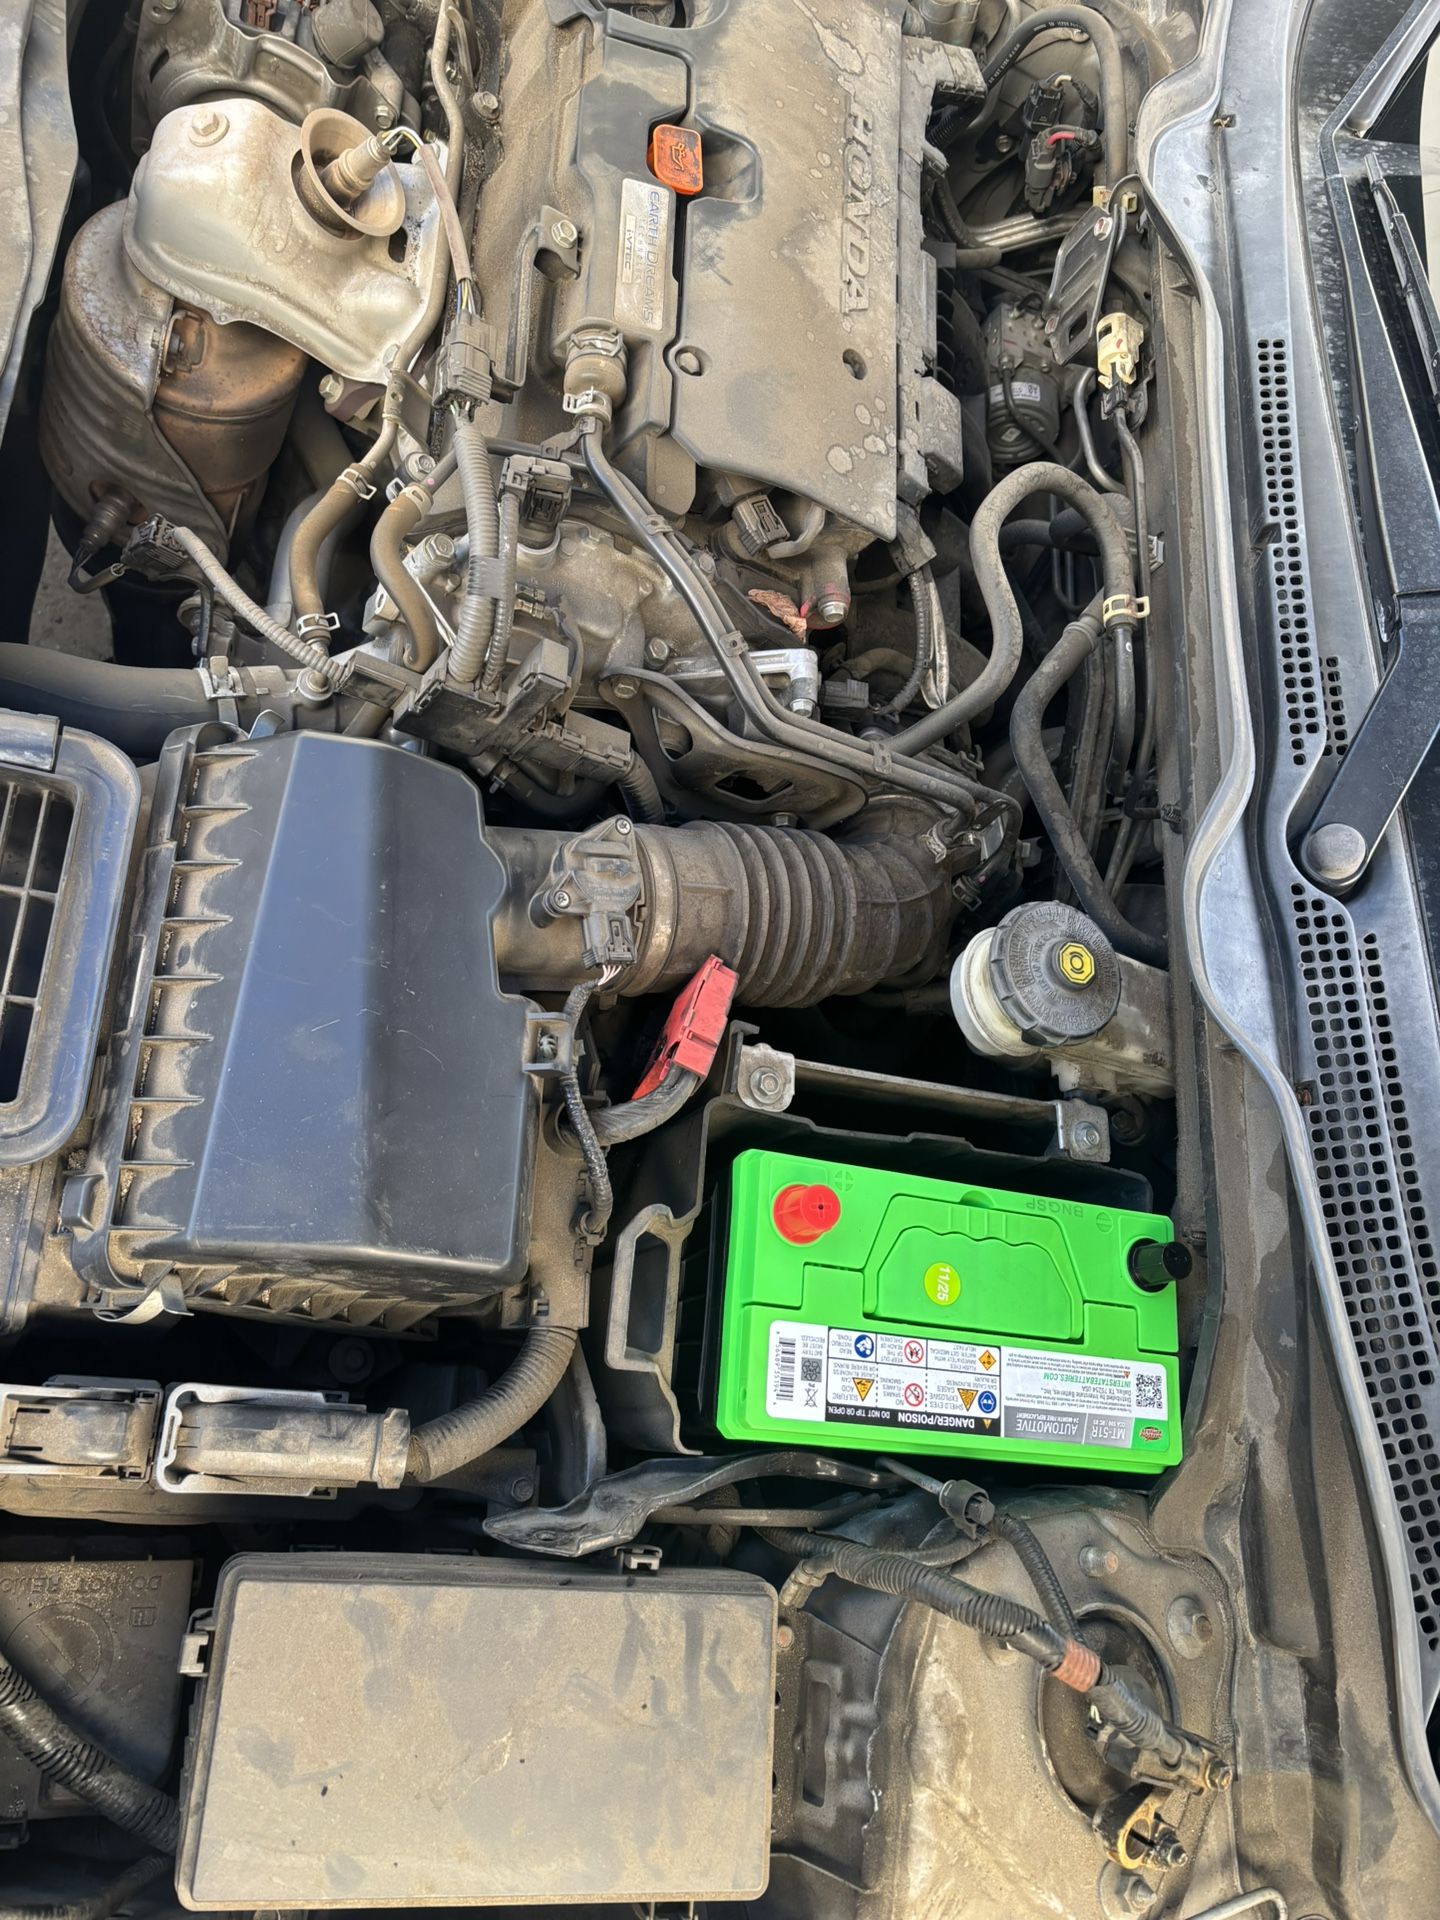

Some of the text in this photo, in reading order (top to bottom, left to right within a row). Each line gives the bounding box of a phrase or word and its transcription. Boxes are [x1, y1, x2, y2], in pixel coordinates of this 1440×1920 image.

[842, 97, 873, 315] HONDA
[642, 190, 660, 325] EARTH DREAMS
[1026, 1198, 1084, 1218] BNGSP
[937, 1266, 951, 1302] 11/25
[886, 1342, 903, 1350] REACH
[801, 1347, 822, 1356] BATTERY
[838, 1347, 852, 1355] READ
[929, 1347, 949, 1355] MEDICAL
[850, 1363, 868, 1371] SEVERE
[1042, 1371, 1131, 1388] INTERSTATEBATTERIES.COM
[840, 1384, 854, 1392] ACID
[936, 1384, 955, 1393] GASES
[1081, 1384, 1092, 1392] USA
[1091, 1385, 1108, 1394] 75254
[1115, 1388, 1131, 1396] Dallas,
[831, 1391, 858, 1401] SULFURIC
[882, 1389, 901, 1398] SPARKS
[928, 1392, 958, 1402] EXPLOSIVE
[1075, 1391, 1099, 1400] Interstate
[1099, 1392, 1105, 1400] by
[894, 1398, 904, 1406] NO
[1106, 1394, 1131, 1403] Distributed
[943, 1401, 963, 1411] SHIELD
[826, 1404, 975, 1428] DANGER/POISON DO NOT TIP OR OPEN.
[1015, 1411, 1046, 1420] REPLACEMENT
[1015, 1418, 1078, 1436] AUTOMOTIVE
[1091, 1425, 1125, 1440] MT-51R
[131, 1575, 162, 1591] DO
